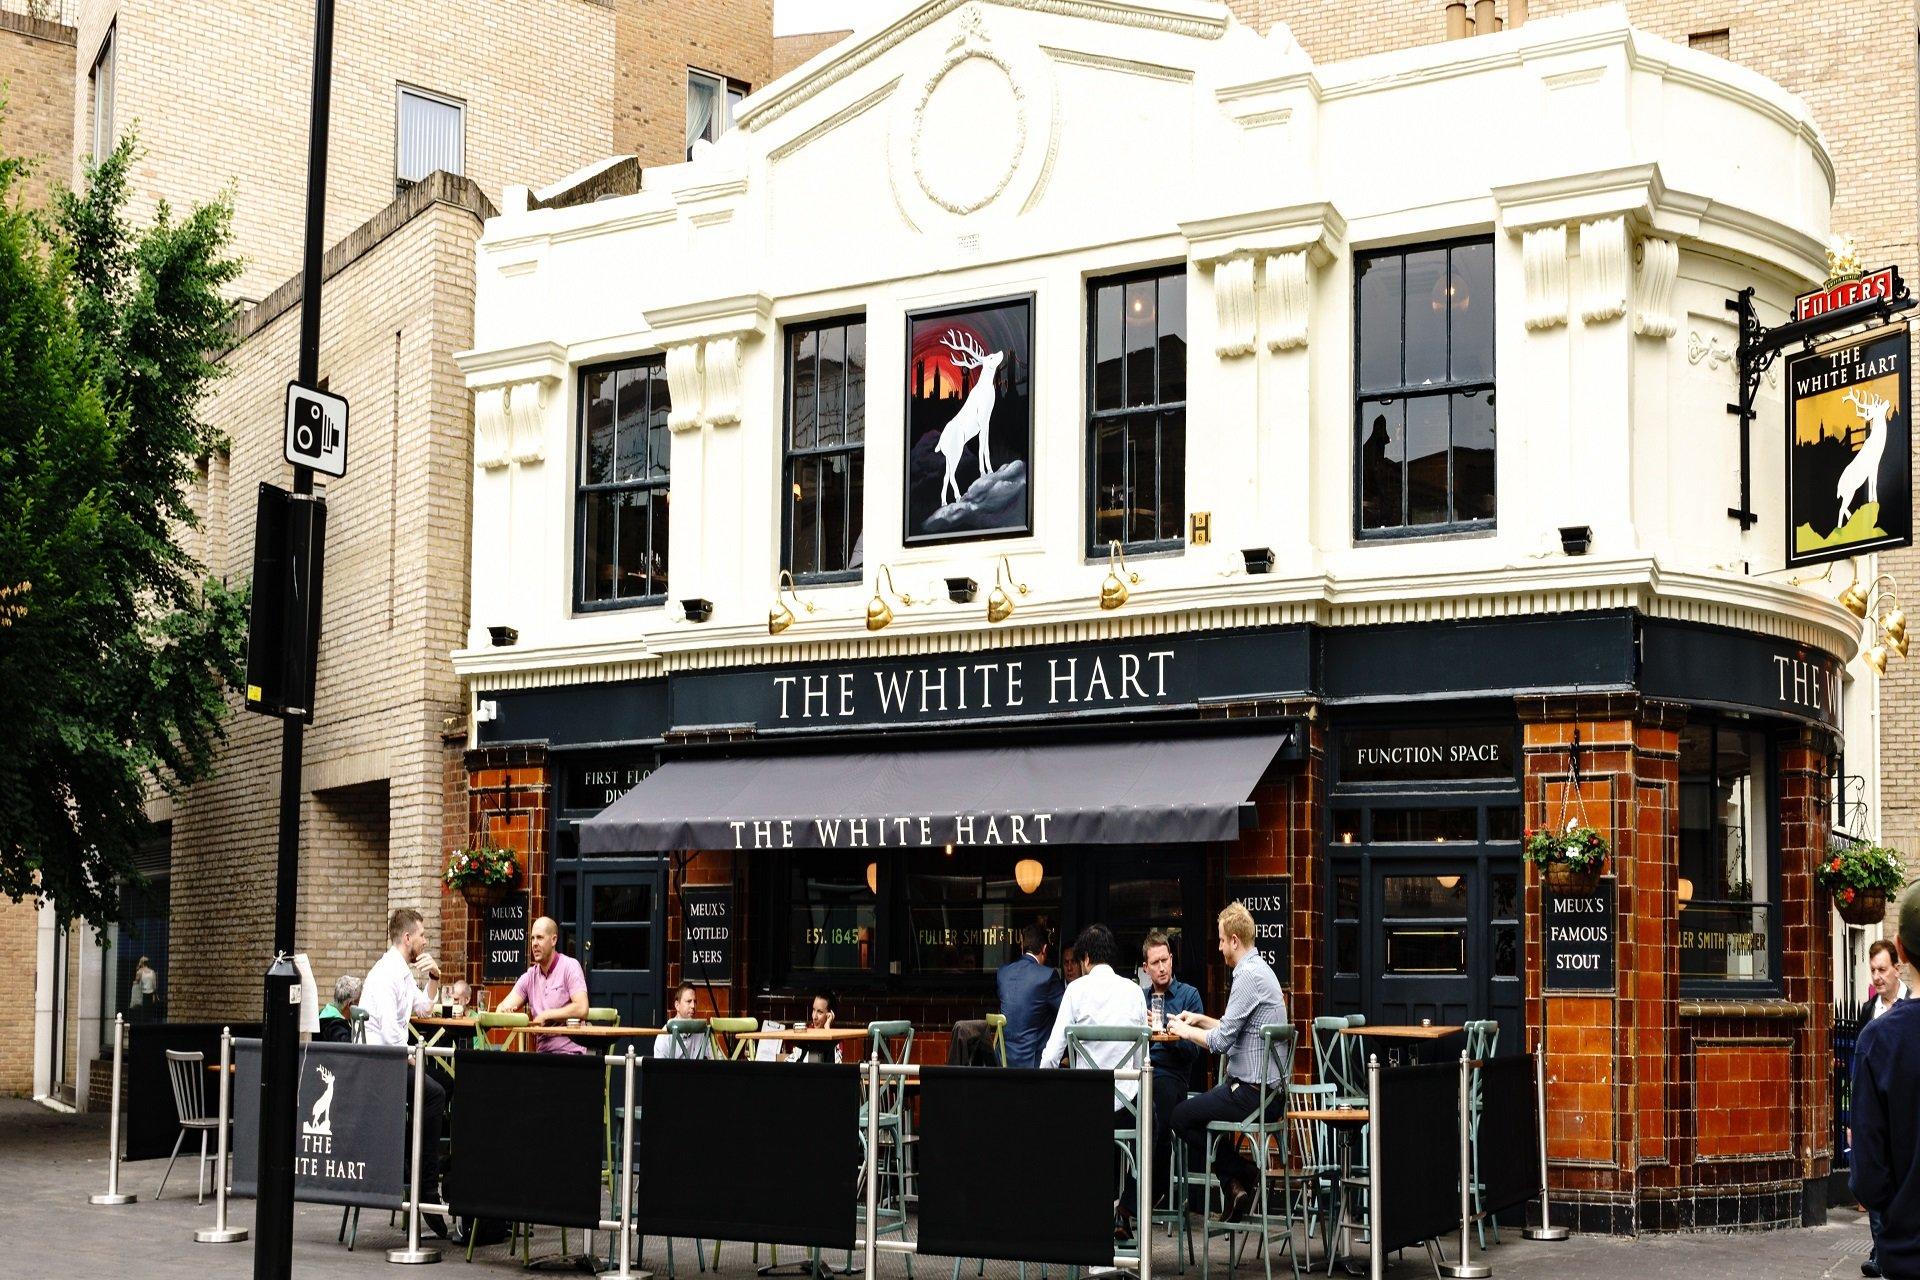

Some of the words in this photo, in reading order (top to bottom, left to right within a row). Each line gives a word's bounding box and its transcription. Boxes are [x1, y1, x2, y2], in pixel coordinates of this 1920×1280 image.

[1801, 276, 1886, 320] FULLER'S
[1829, 346, 1860, 368] THE
[1797, 368, 1848, 396] WHITE
[1855, 354, 1898, 380] HART
[1192, 514, 1209, 543] H
[773, 673, 855, 719] THE
[874, 661, 1023, 714] WHITE
[1048, 650, 1175, 704] HART
[1773, 654, 1821, 710] THE
[1358, 746, 1443, 764] FUNCTION
[1450, 744, 1499, 762] SPACE
[585, 770, 618, 786] FIRST
[627, 769, 652, 784] FLO
[730, 820, 794, 849] THE
[815, 816, 932, 847] WHITE
[955, 813, 1051, 845] HART
[491, 906, 523, 919] MEUX'S
[690, 902, 726, 917] MEUX'S
[1553, 897, 1604, 913] MEUX'S
[489, 928, 525, 941] FAMOUS
[831, 928, 859, 945] 1845
[919, 929, 958, 946] FULLER
[962, 929, 997, 946] SMITH
[1255, 924, 1284, 938] FECT
[1550, 926, 1608, 941] FAMOUS
[1678, 931, 1694, 949] LER
[1698, 931, 1725, 950] SMITH
[491, 950, 520, 963] STOUT
[692, 950, 723, 964] BEERS
[1260, 950, 1276, 965] ES
[1556, 953, 1600, 970] STOUT
[302, 1134, 332, 1154] THE
[295, 1157, 318, 1176] ITE
[325, 1159, 366, 1180] HART
